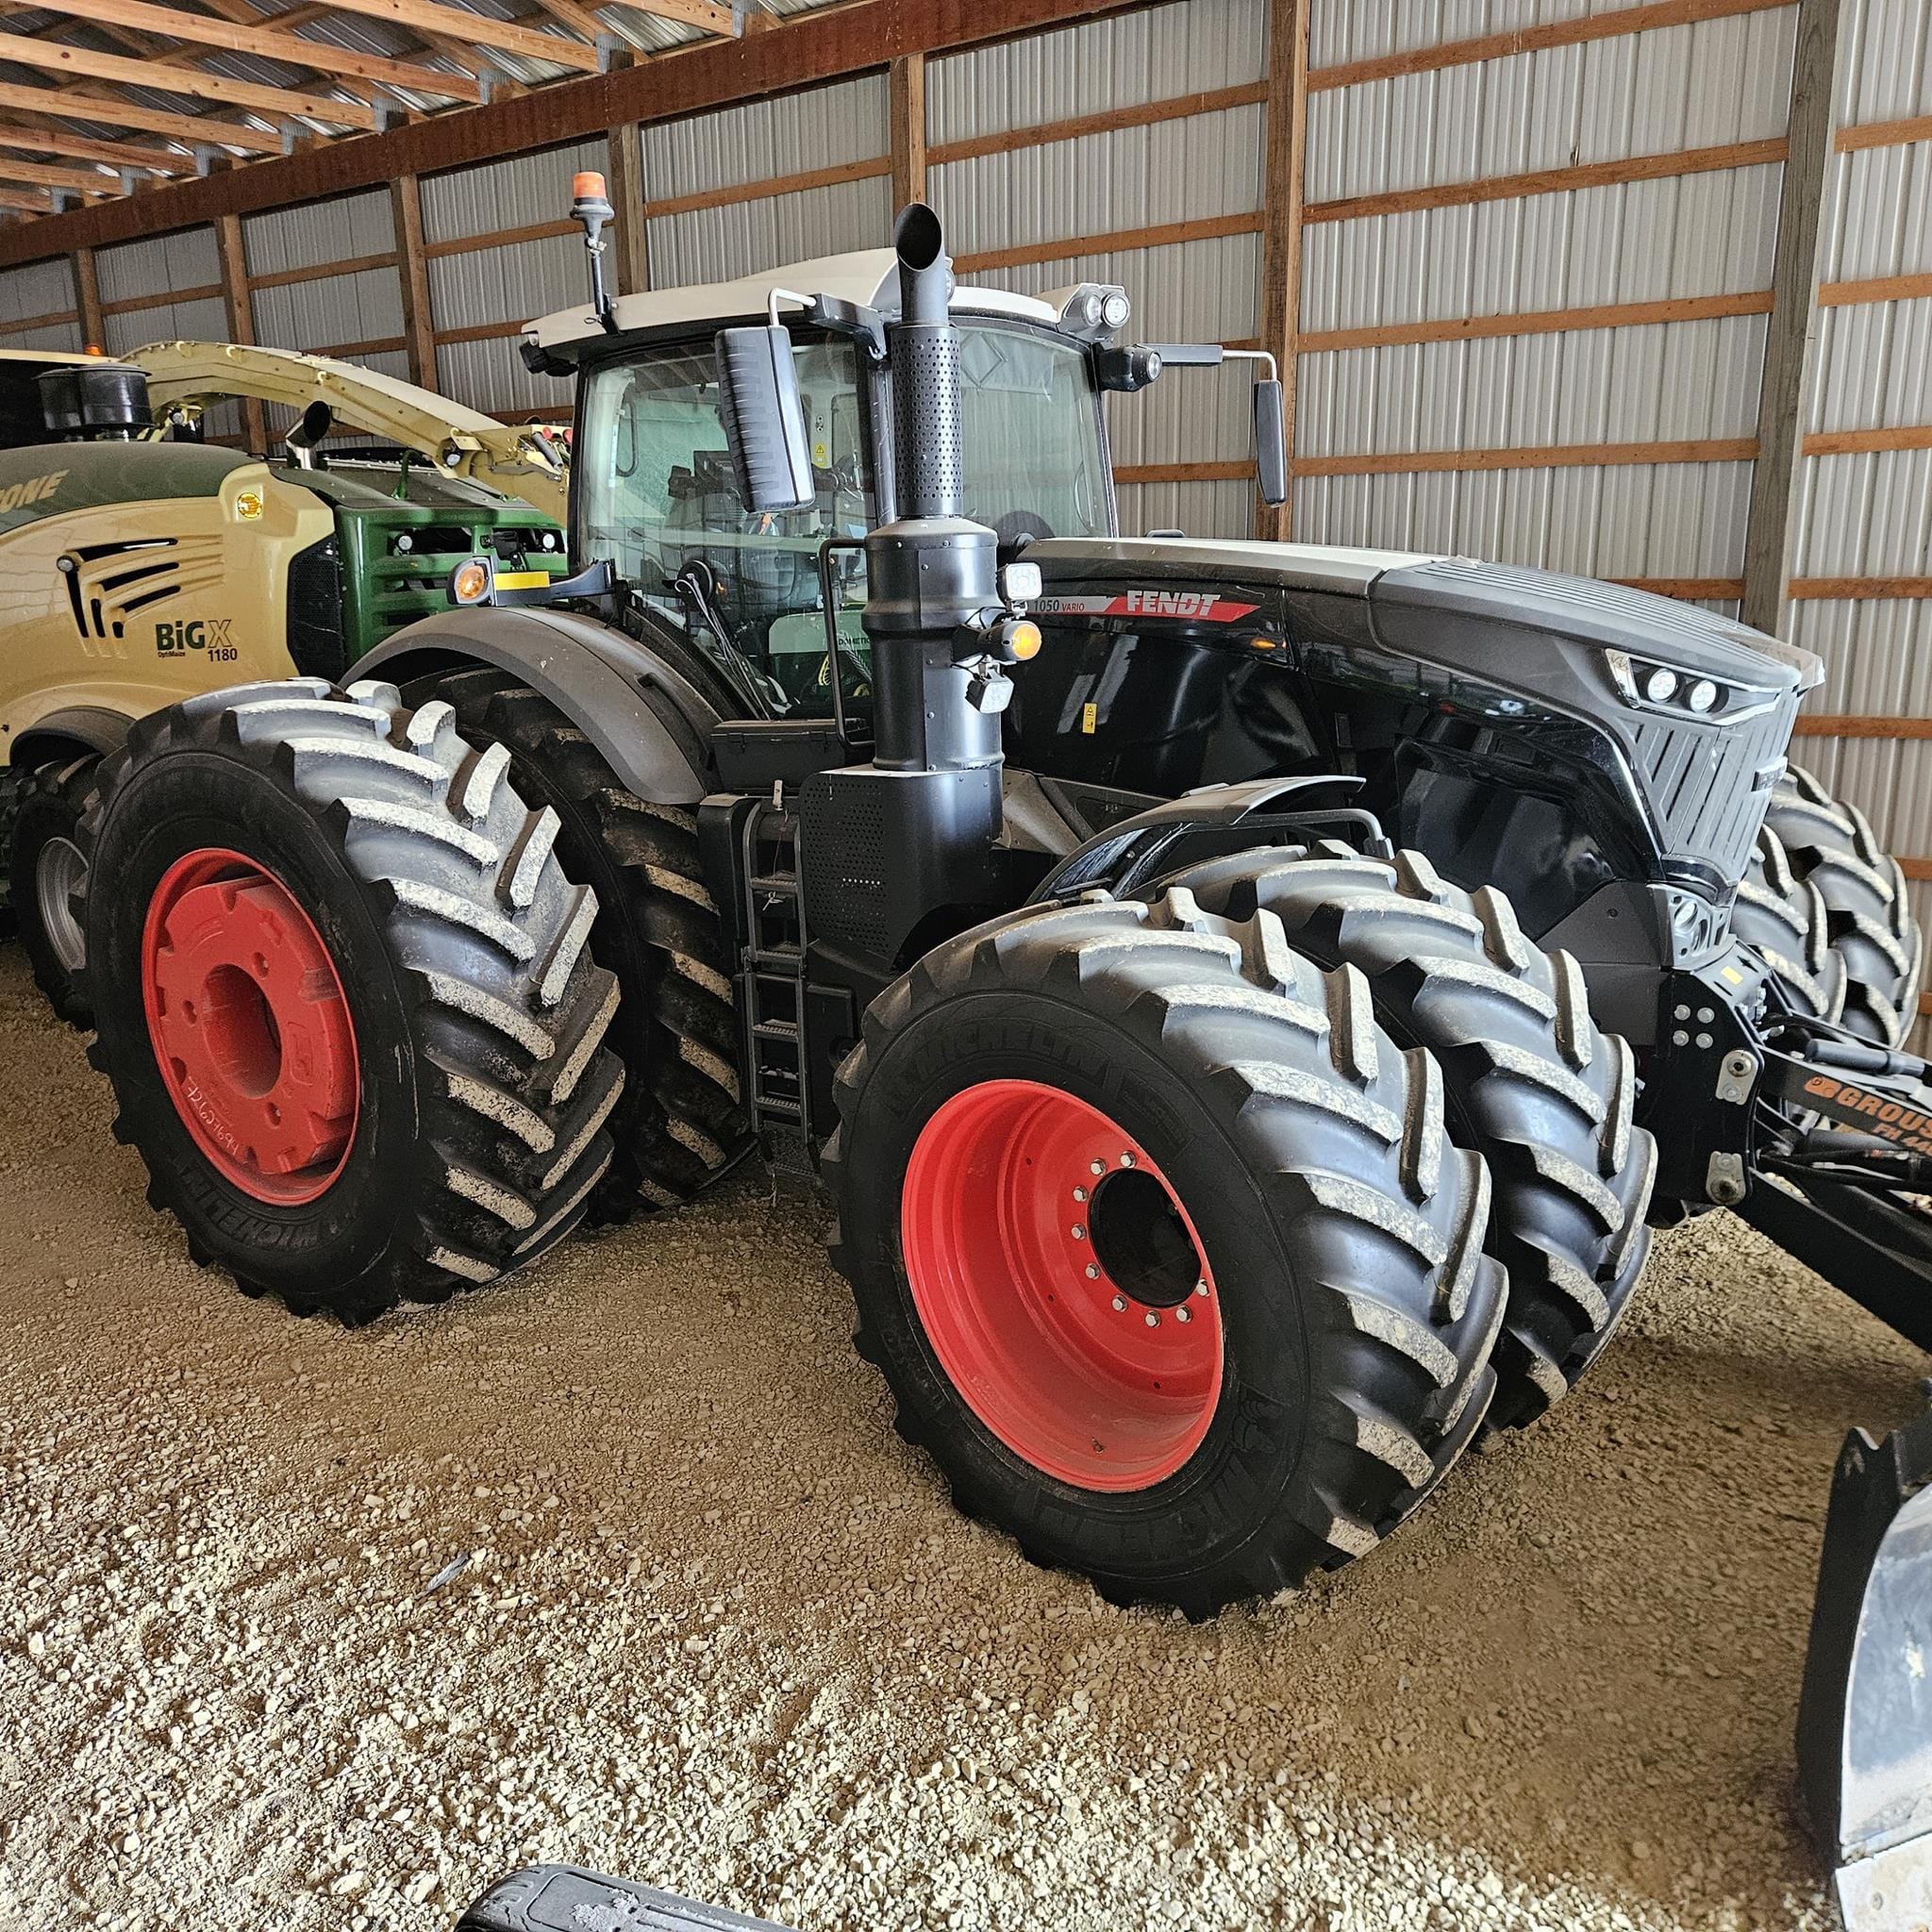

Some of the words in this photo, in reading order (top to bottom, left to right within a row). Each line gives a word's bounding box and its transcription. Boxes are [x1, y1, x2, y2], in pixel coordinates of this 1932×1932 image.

[1034, 598, 1060, 612] 1050
[1061, 603, 1085, 612] VARIO
[1126, 590, 1221, 616] FENDT
[208, 648, 238, 662] 1180
